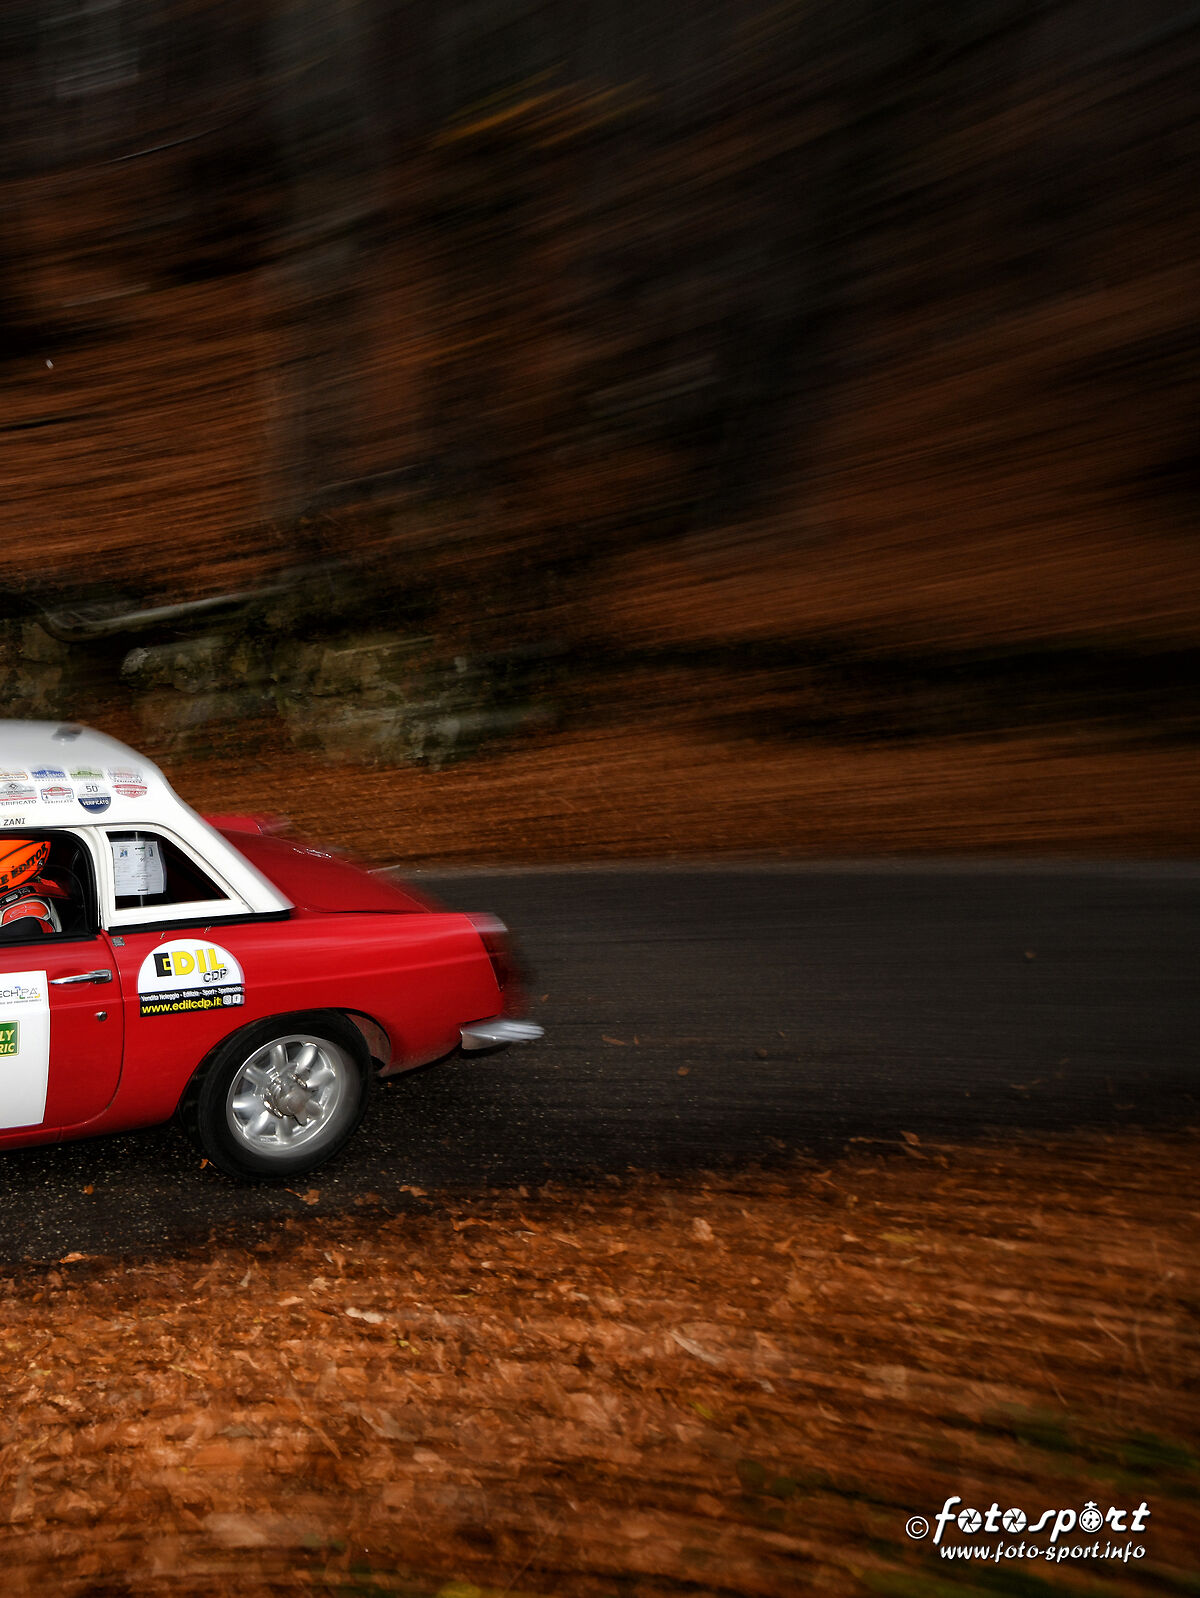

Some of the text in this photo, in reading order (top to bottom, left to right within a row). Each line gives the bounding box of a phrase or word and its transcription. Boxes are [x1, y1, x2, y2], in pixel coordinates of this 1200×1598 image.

[3, 817, 26, 826] ZANI
[11, 843, 48, 879] EDITOR
[153, 948, 225, 978] EDIL
[203, 968, 228, 983] CDP
[141, 996, 223, 1014] www.edilcdp.it
